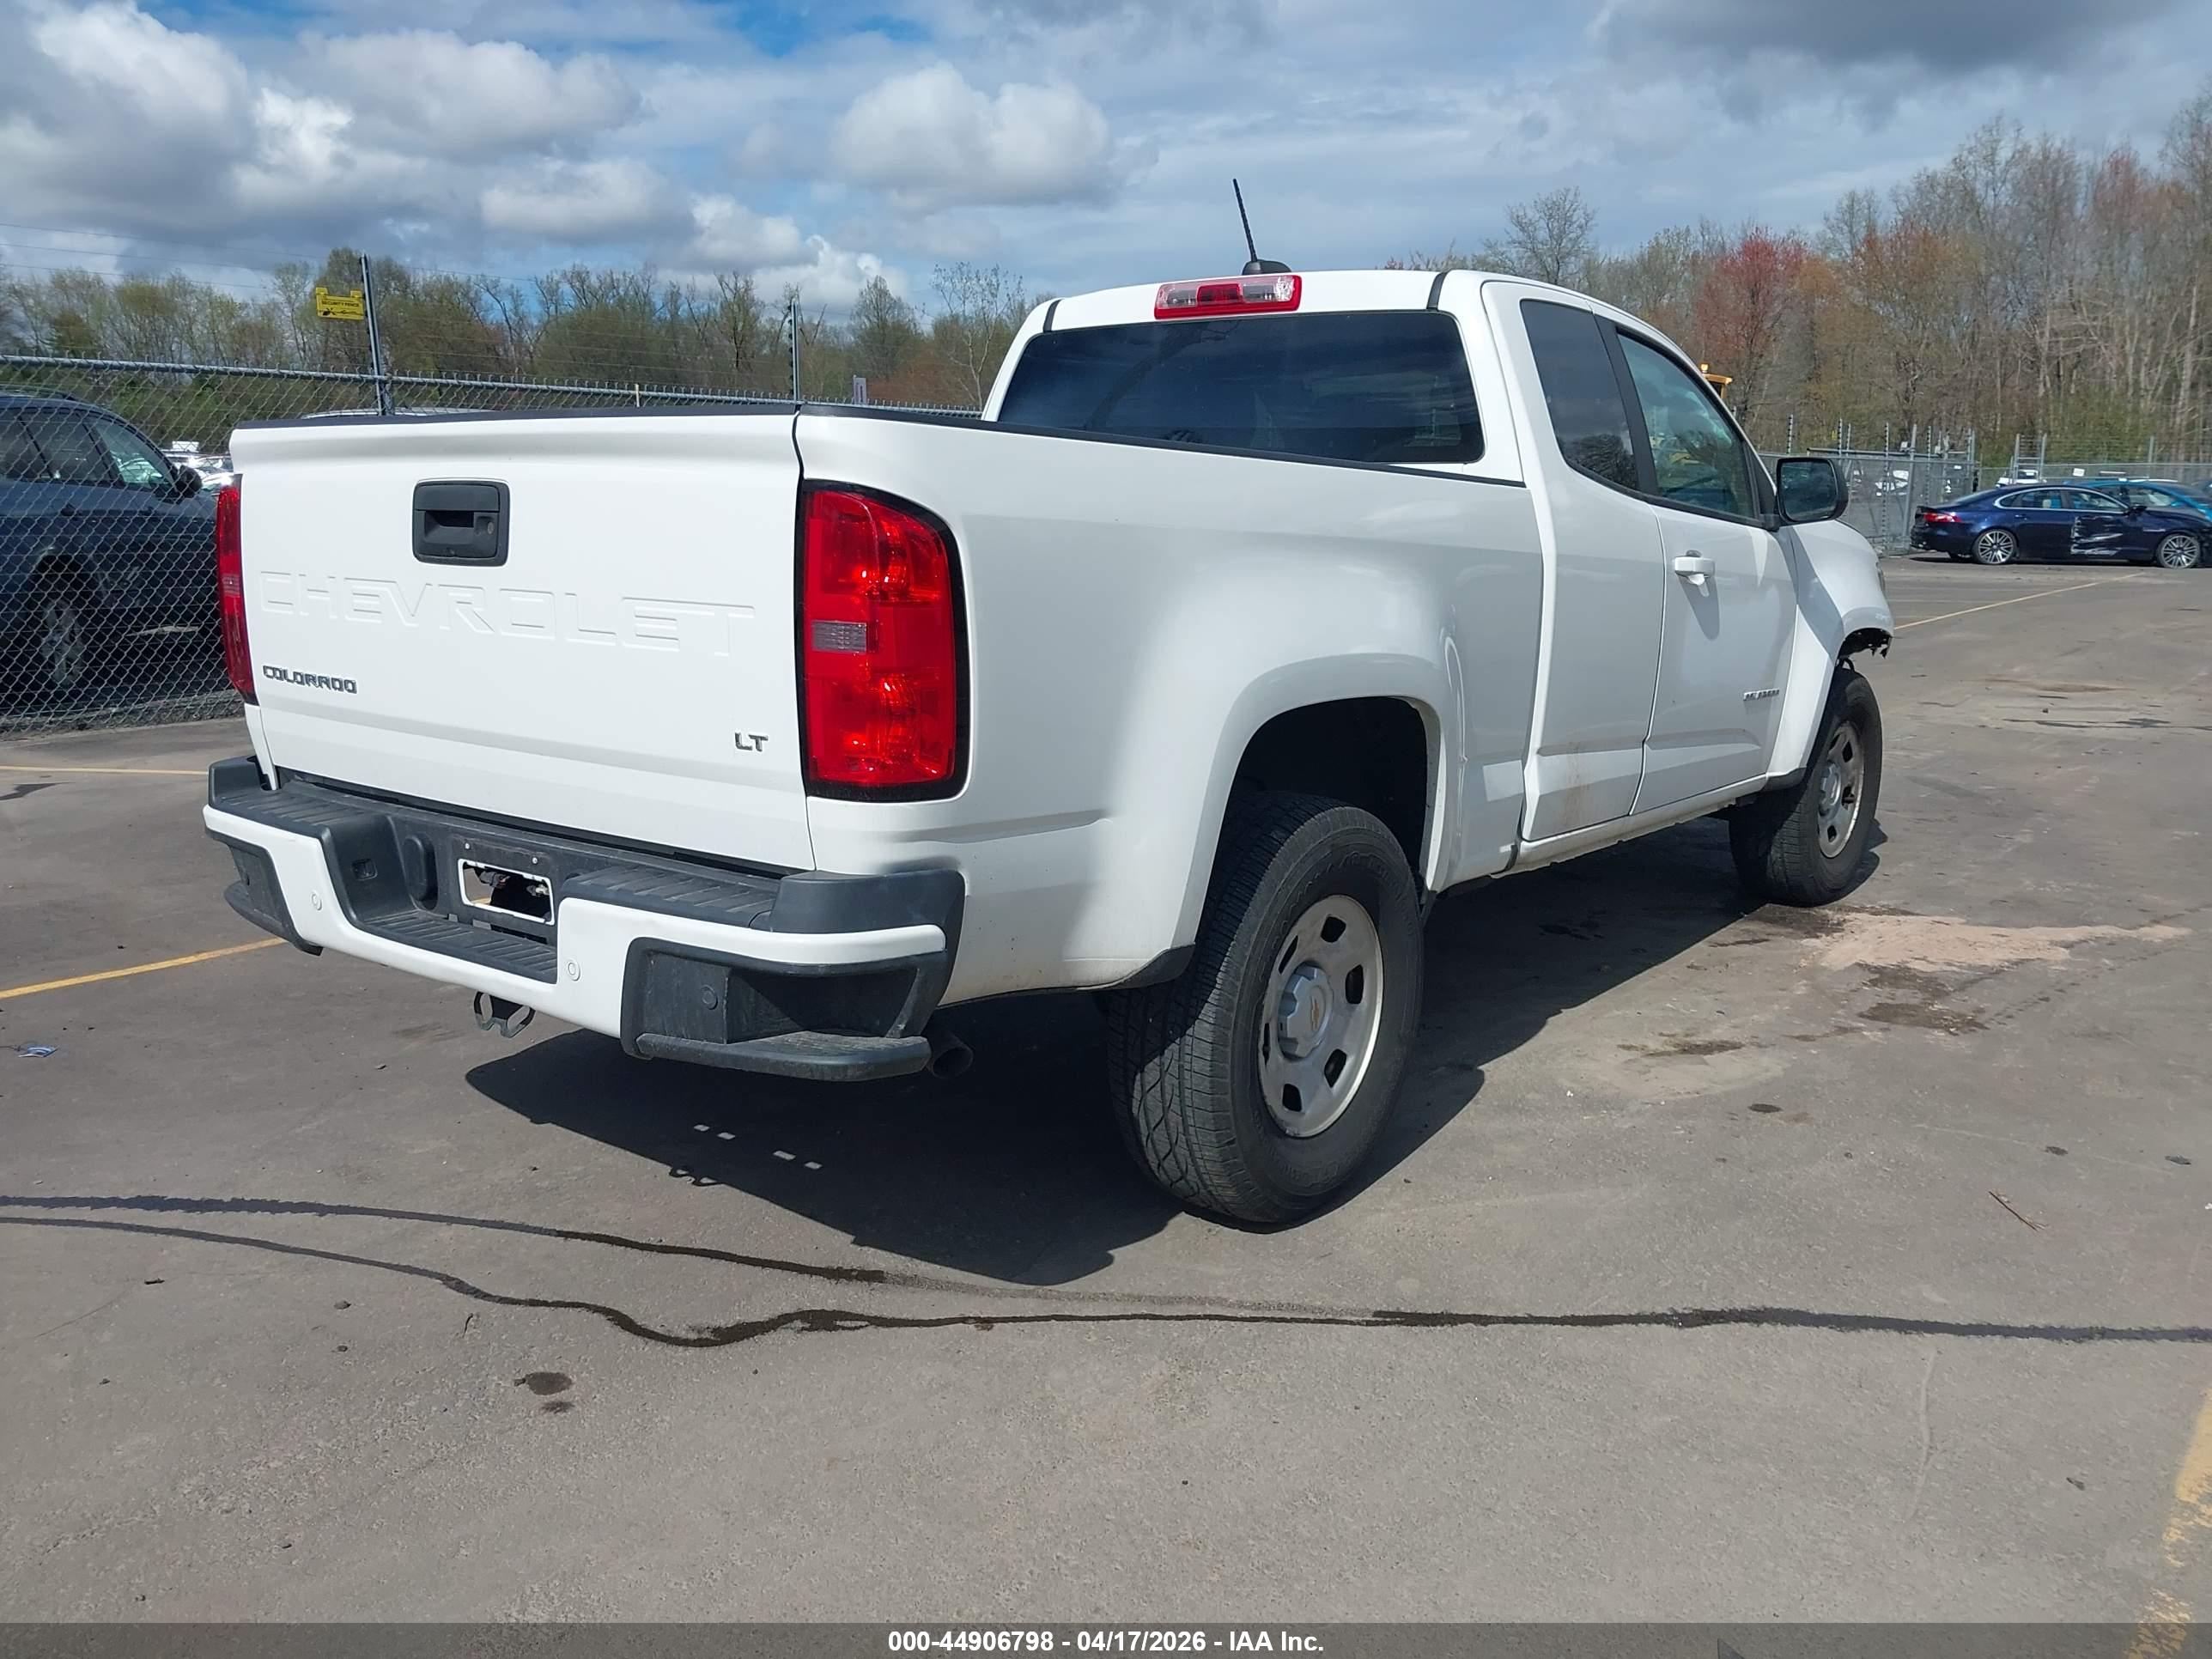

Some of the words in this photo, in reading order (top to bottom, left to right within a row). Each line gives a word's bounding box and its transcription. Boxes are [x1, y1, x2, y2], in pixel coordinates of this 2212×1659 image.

[260, 570, 756, 658] CHEVROLET
[262, 665, 358, 695] COLORADO
[734, 732, 769, 752] LT
